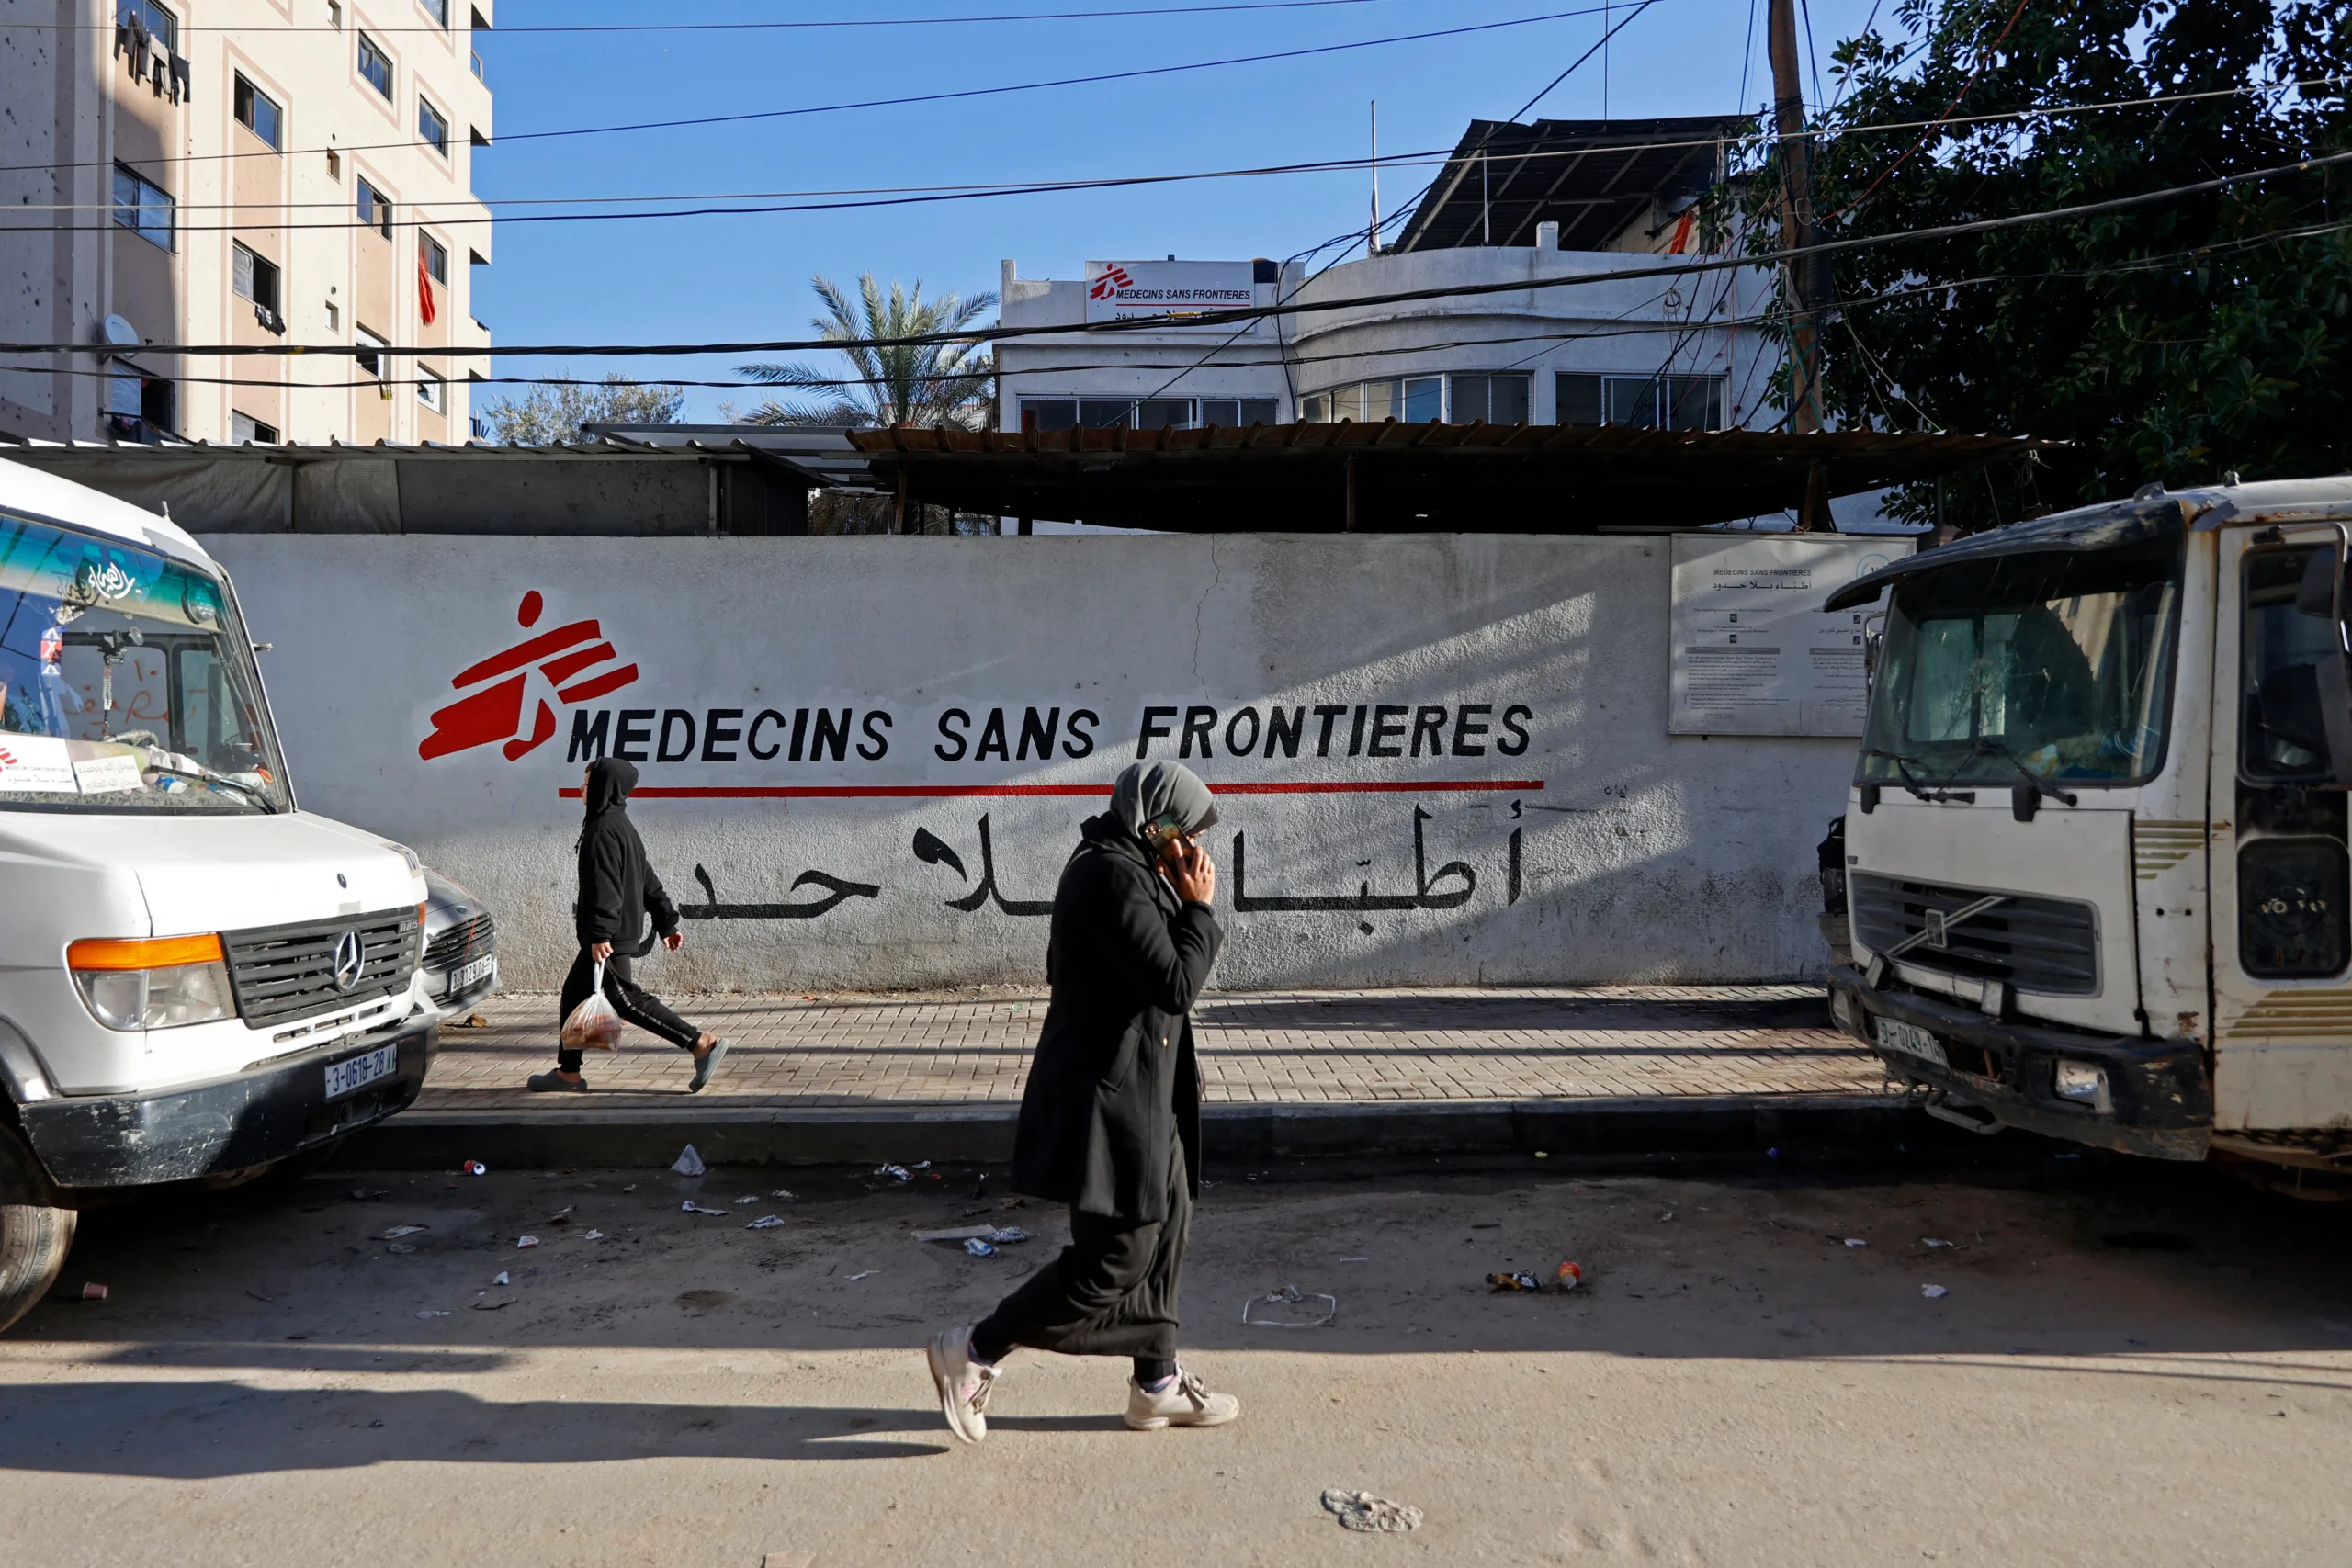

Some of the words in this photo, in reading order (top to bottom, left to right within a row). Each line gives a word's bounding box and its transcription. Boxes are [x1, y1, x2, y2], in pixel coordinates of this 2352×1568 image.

[1116, 289, 1164, 299] MEDECINS
[1166, 289, 1191, 299] SANS
[1193, 290, 1250, 299] FRONTIERES
[1713, 582, 1747, 591] حدود
[567, 708, 893, 763] MEDECINS
[934, 707, 1100, 761] SANS
[1136, 705, 1533, 759] FRONTIERES
[913, 812, 1056, 916] لا
[333, 1051, 384, 1092] 3-0618-28
